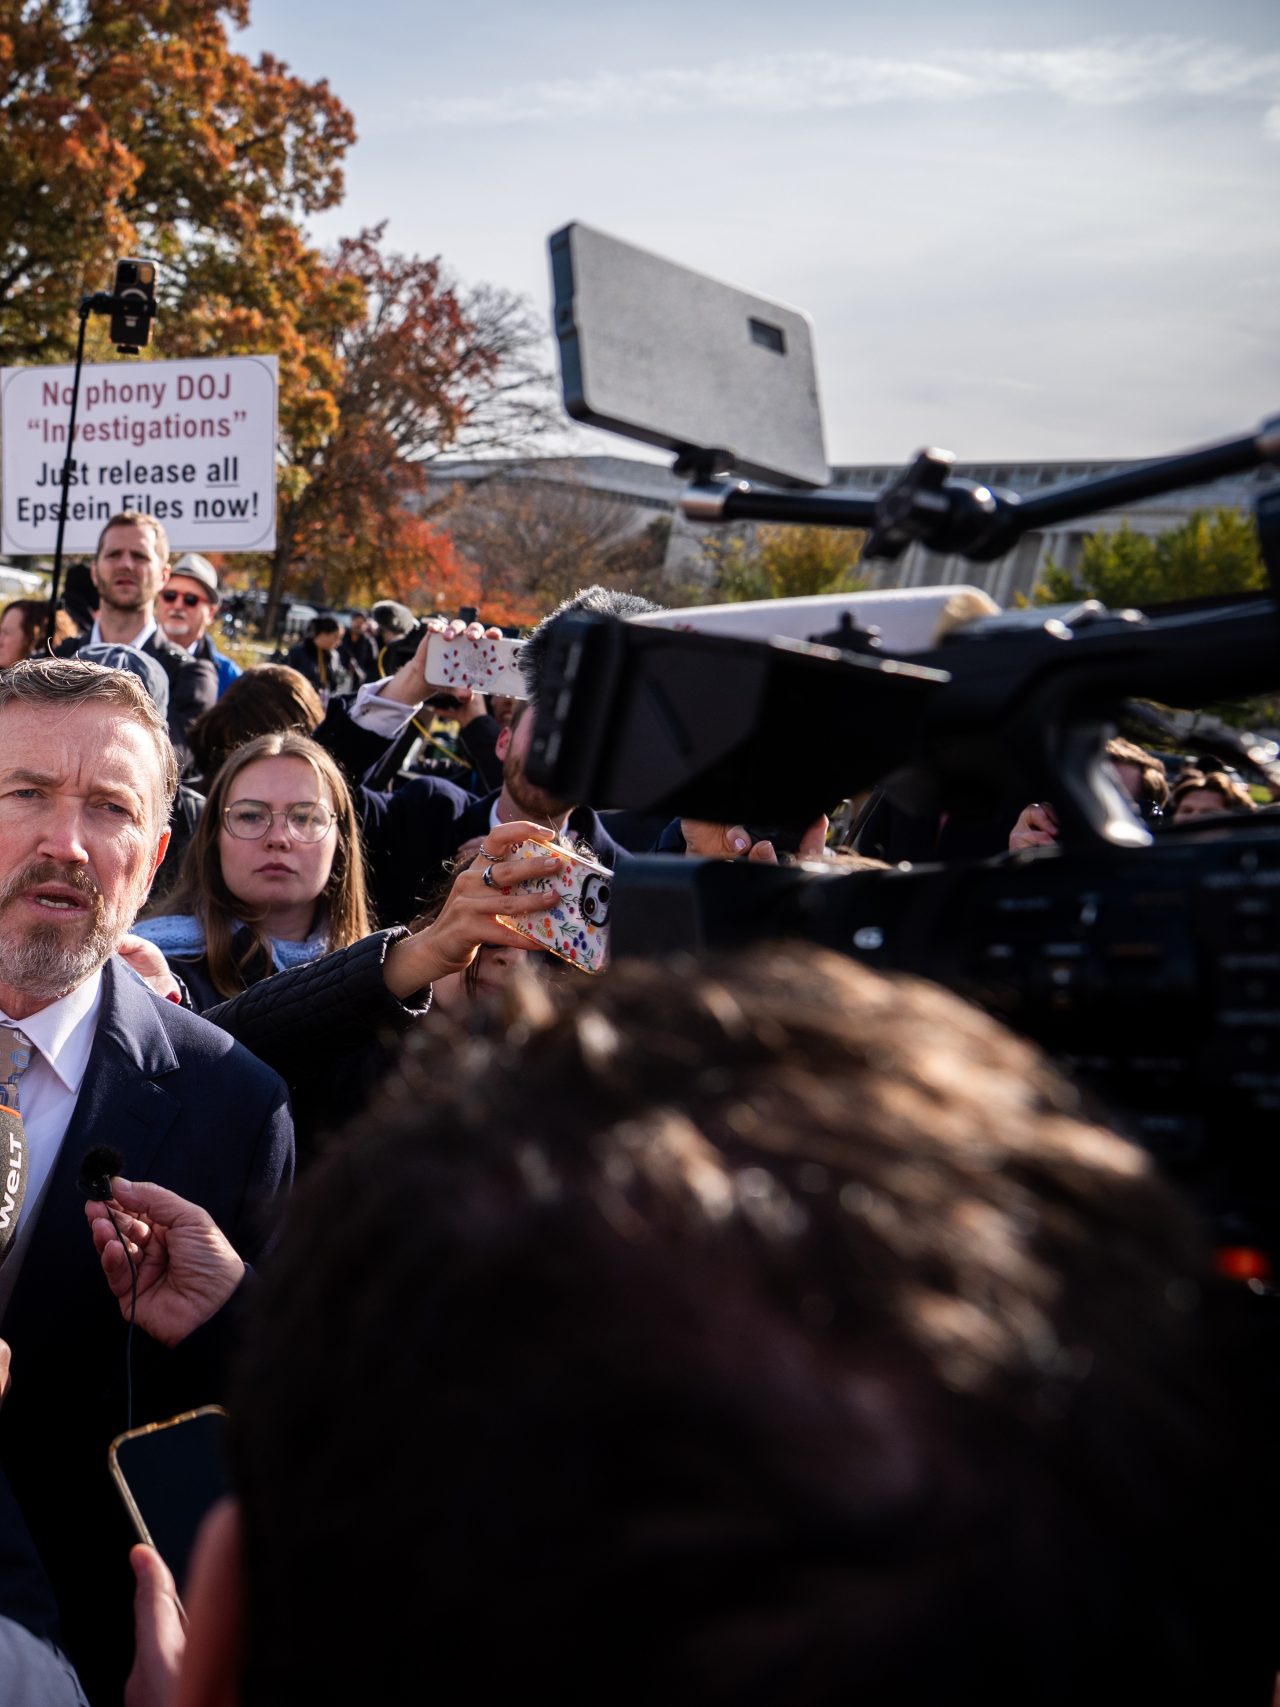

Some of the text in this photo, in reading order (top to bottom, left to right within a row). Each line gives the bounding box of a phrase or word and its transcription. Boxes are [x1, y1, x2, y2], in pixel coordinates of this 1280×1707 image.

[86, 379, 166, 411] phony
[177, 374, 232, 401] DOJ
[99, 460, 197, 485] release
[206, 457, 239, 482] all
[17, 492, 258, 528] Epsein Files now!
